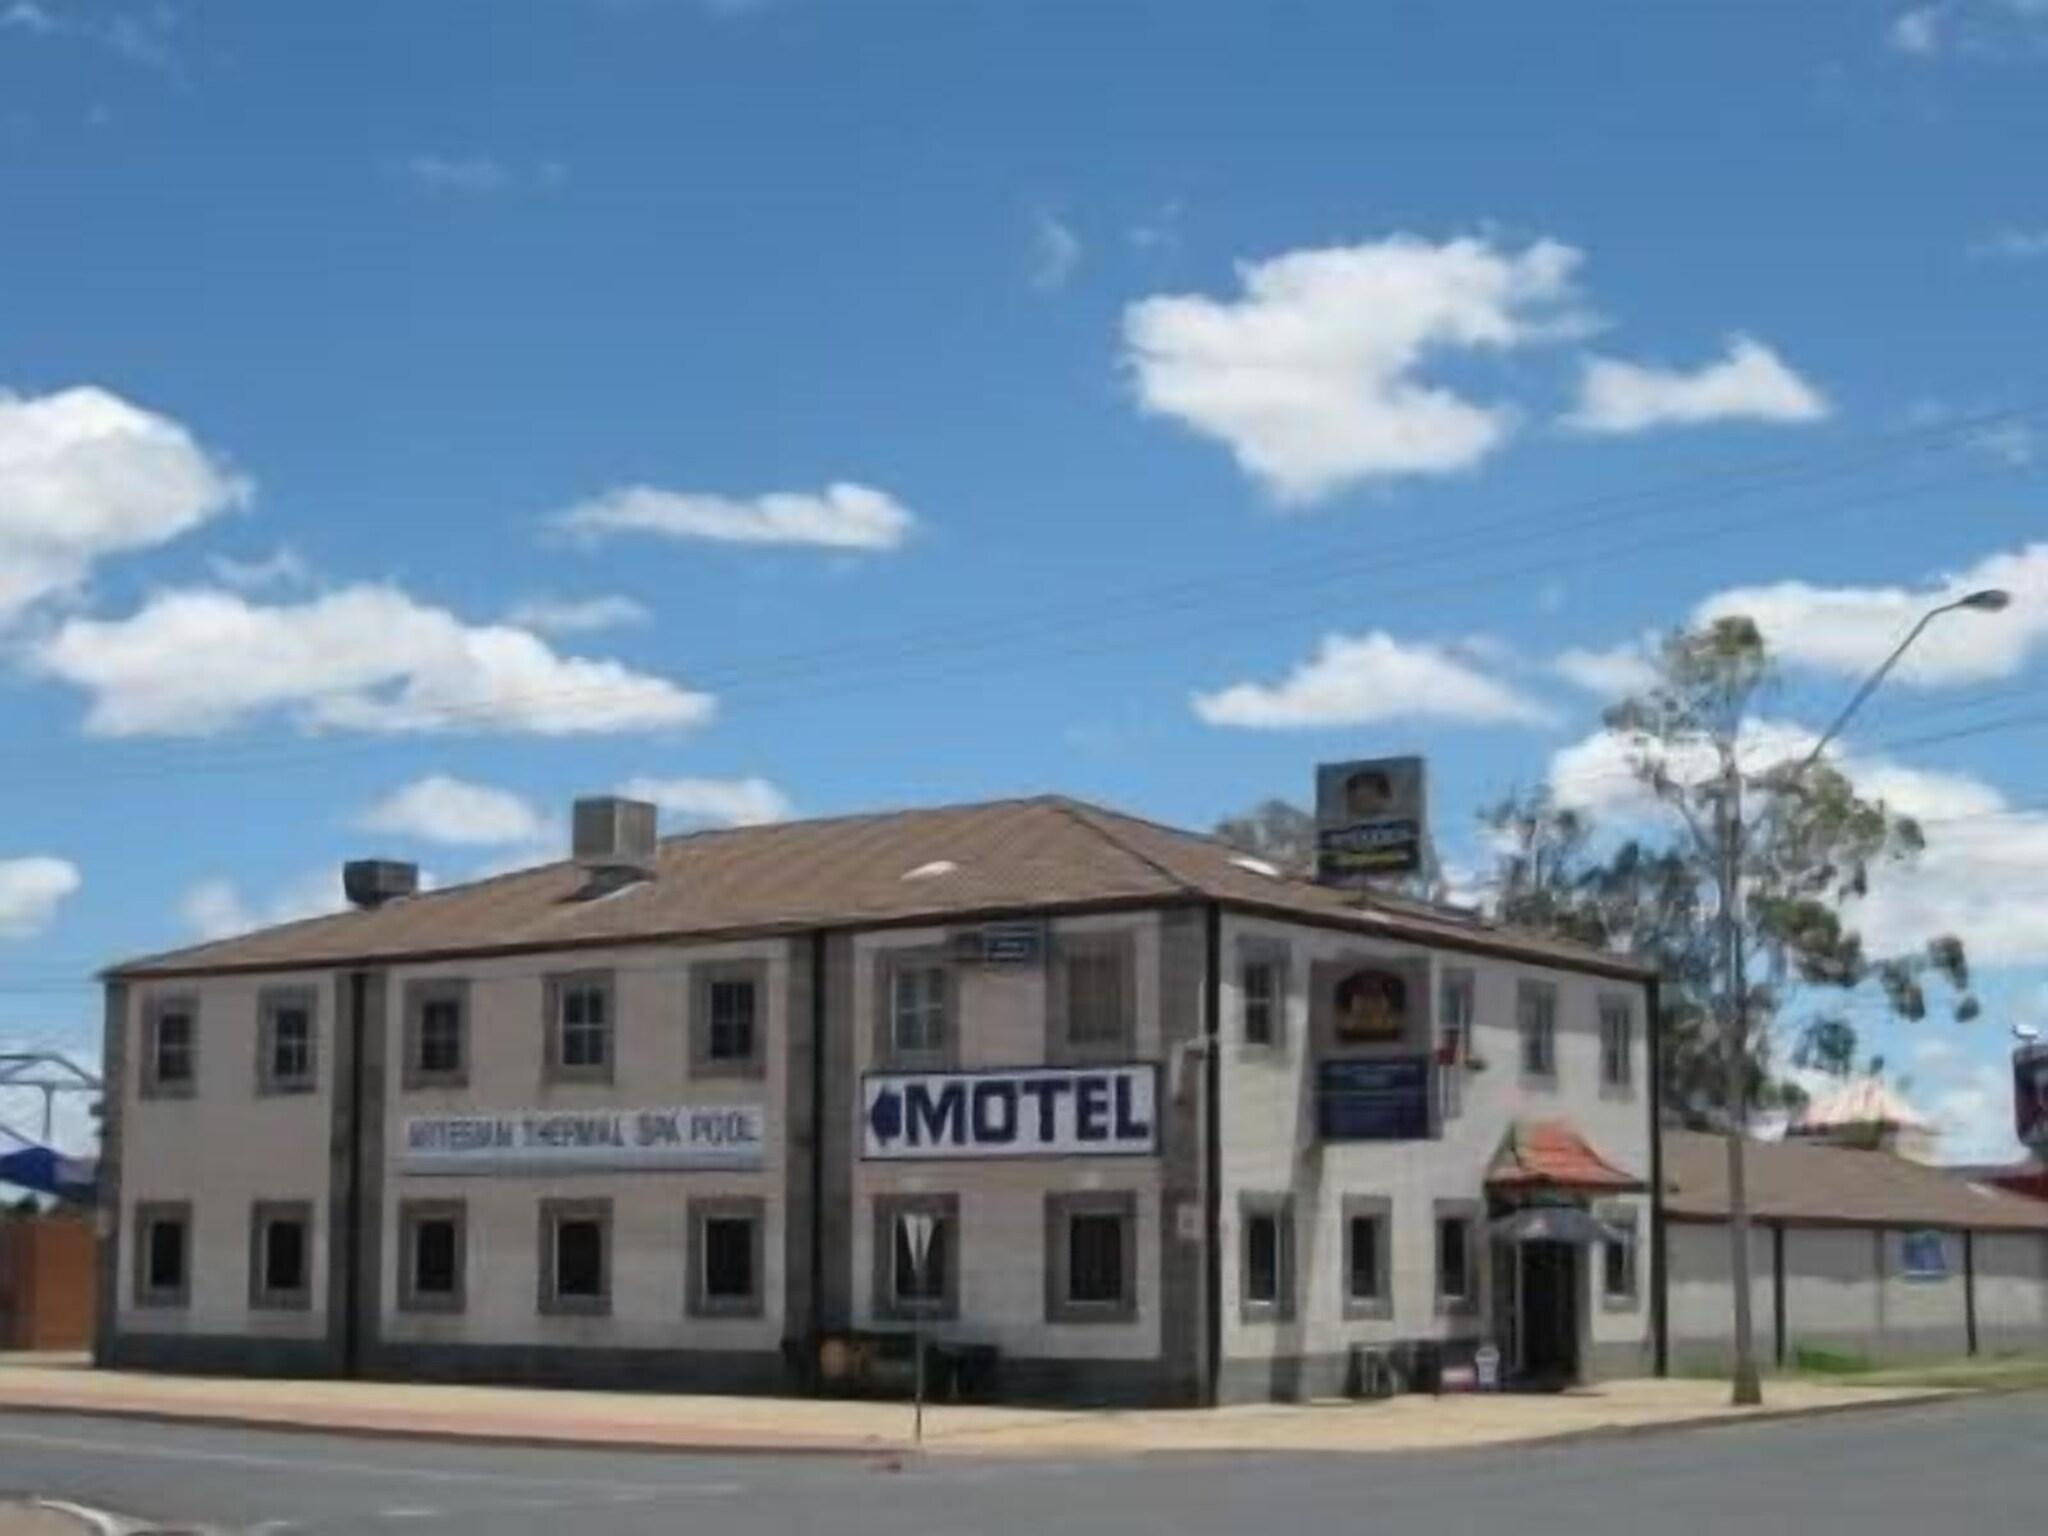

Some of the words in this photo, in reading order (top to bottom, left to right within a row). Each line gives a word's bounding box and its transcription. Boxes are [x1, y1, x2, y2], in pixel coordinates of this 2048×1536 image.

[638, 1113, 681, 1146] SPA
[691, 1112, 760, 1144] POOL
[905, 1075, 1149, 1146] MOTEL
